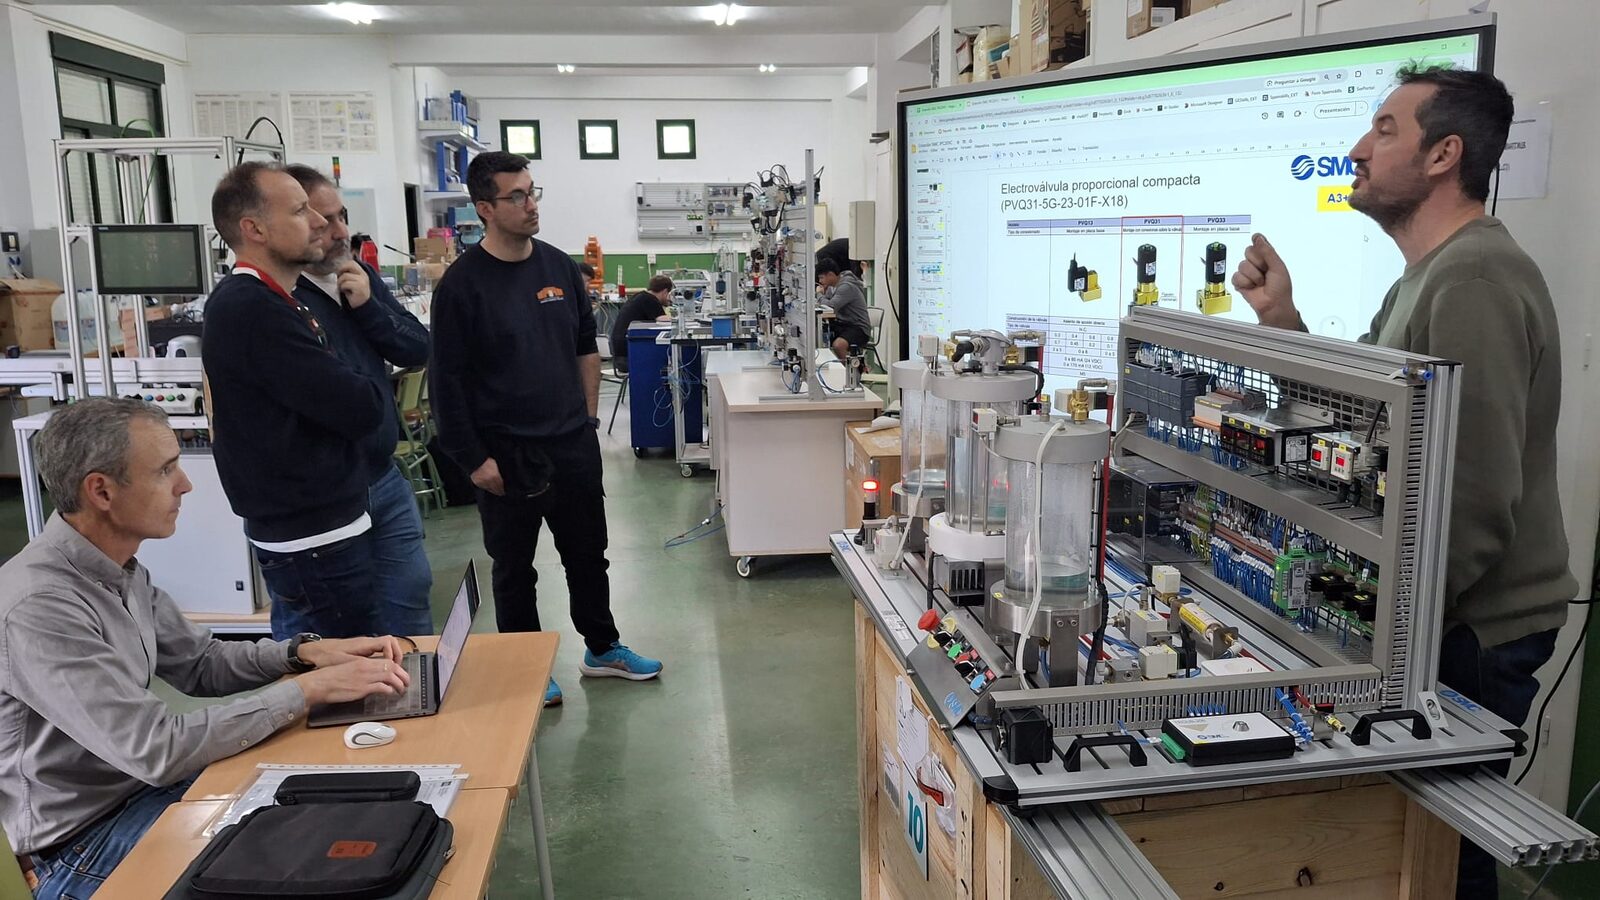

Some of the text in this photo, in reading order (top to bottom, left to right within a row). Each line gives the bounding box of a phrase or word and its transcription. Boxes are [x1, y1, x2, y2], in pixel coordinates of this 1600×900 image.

[1001, 173, 1201, 194] Electroválvula proporcional compacta
[1000, 195, 1129, 213] (PVQ31-5G-23-01F-X18)
[907, 790, 924, 854] 10
